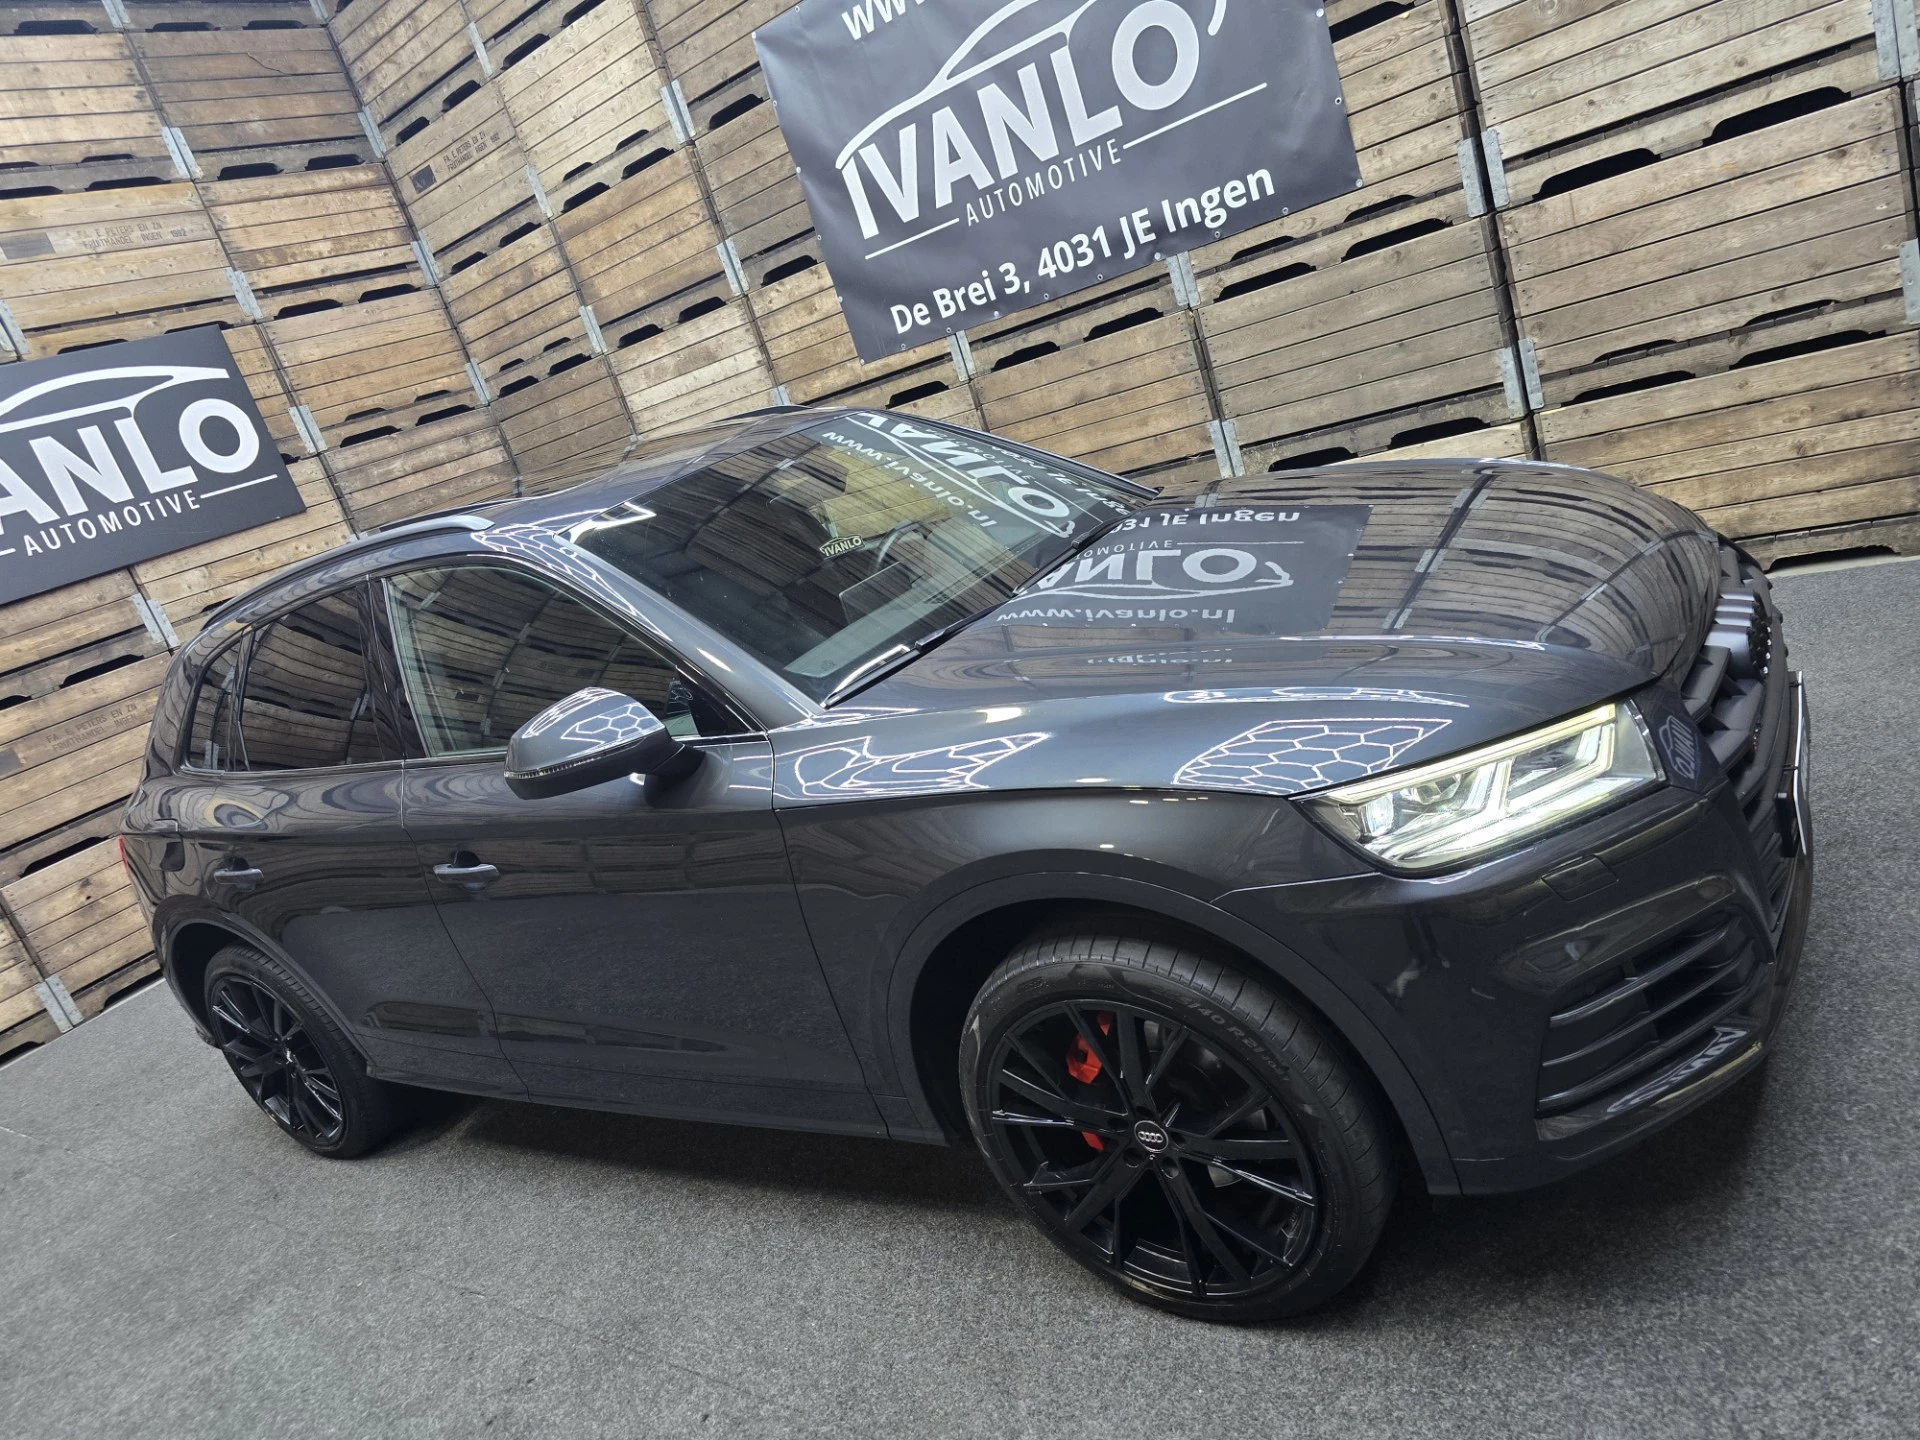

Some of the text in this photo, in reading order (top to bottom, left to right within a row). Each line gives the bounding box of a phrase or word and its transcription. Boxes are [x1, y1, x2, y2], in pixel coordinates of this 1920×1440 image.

[841, 0, 1200, 240] IVANLO
[966, 137, 1122, 227] AUTOMOTIVE
[890, 166, 1276, 334] De Brei 3, 4031 JE Ingen
[23, 489, 200, 557] AUTOMOTIVE
[824, 537, 862, 557] IVANLO
[76, 716, 107, 732] PETERS
[111, 708, 123, 718] EN
